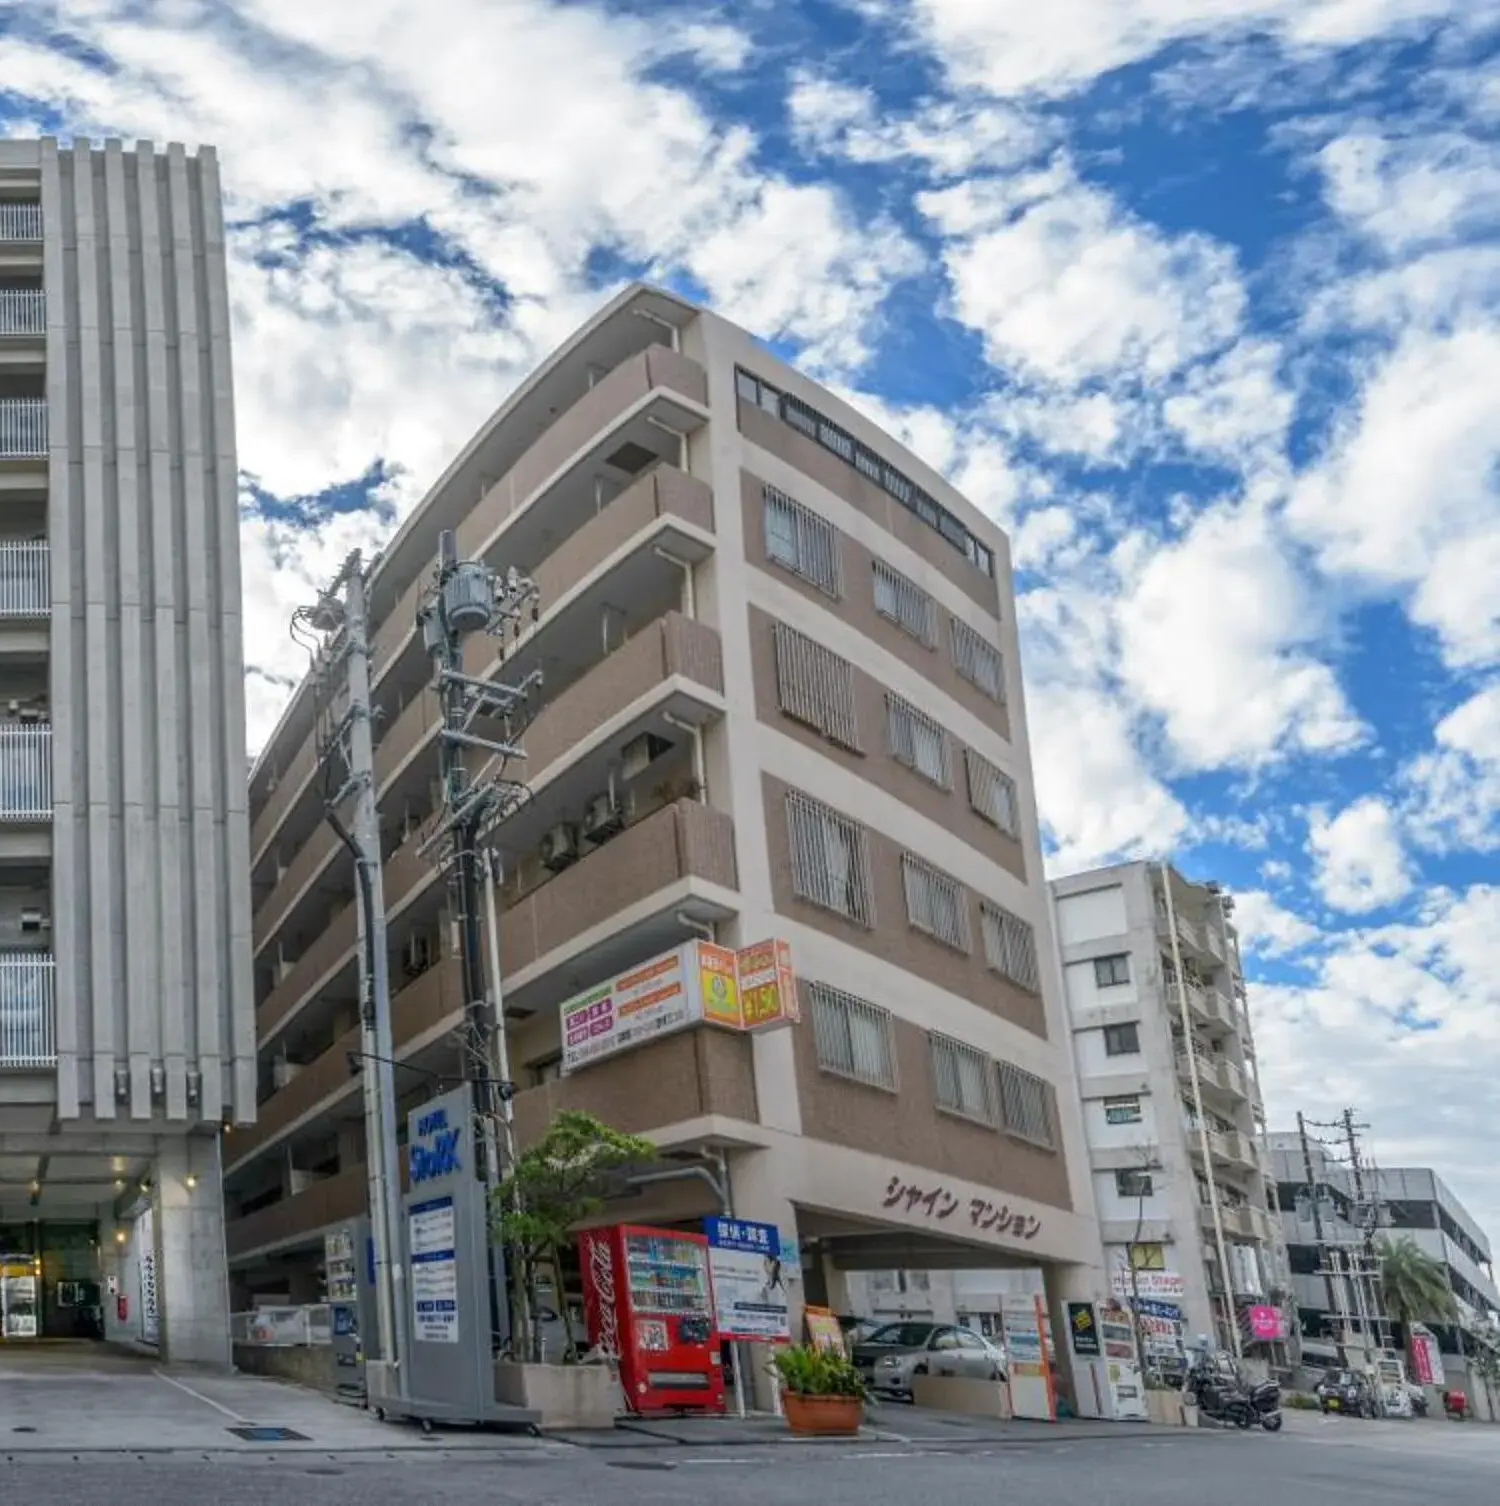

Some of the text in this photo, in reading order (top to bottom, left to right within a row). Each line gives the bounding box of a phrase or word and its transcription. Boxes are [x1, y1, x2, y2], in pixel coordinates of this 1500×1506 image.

[418, 1110, 448, 1136] HOTEL
[882, 1176, 1042, 1240] シャイン マンション
